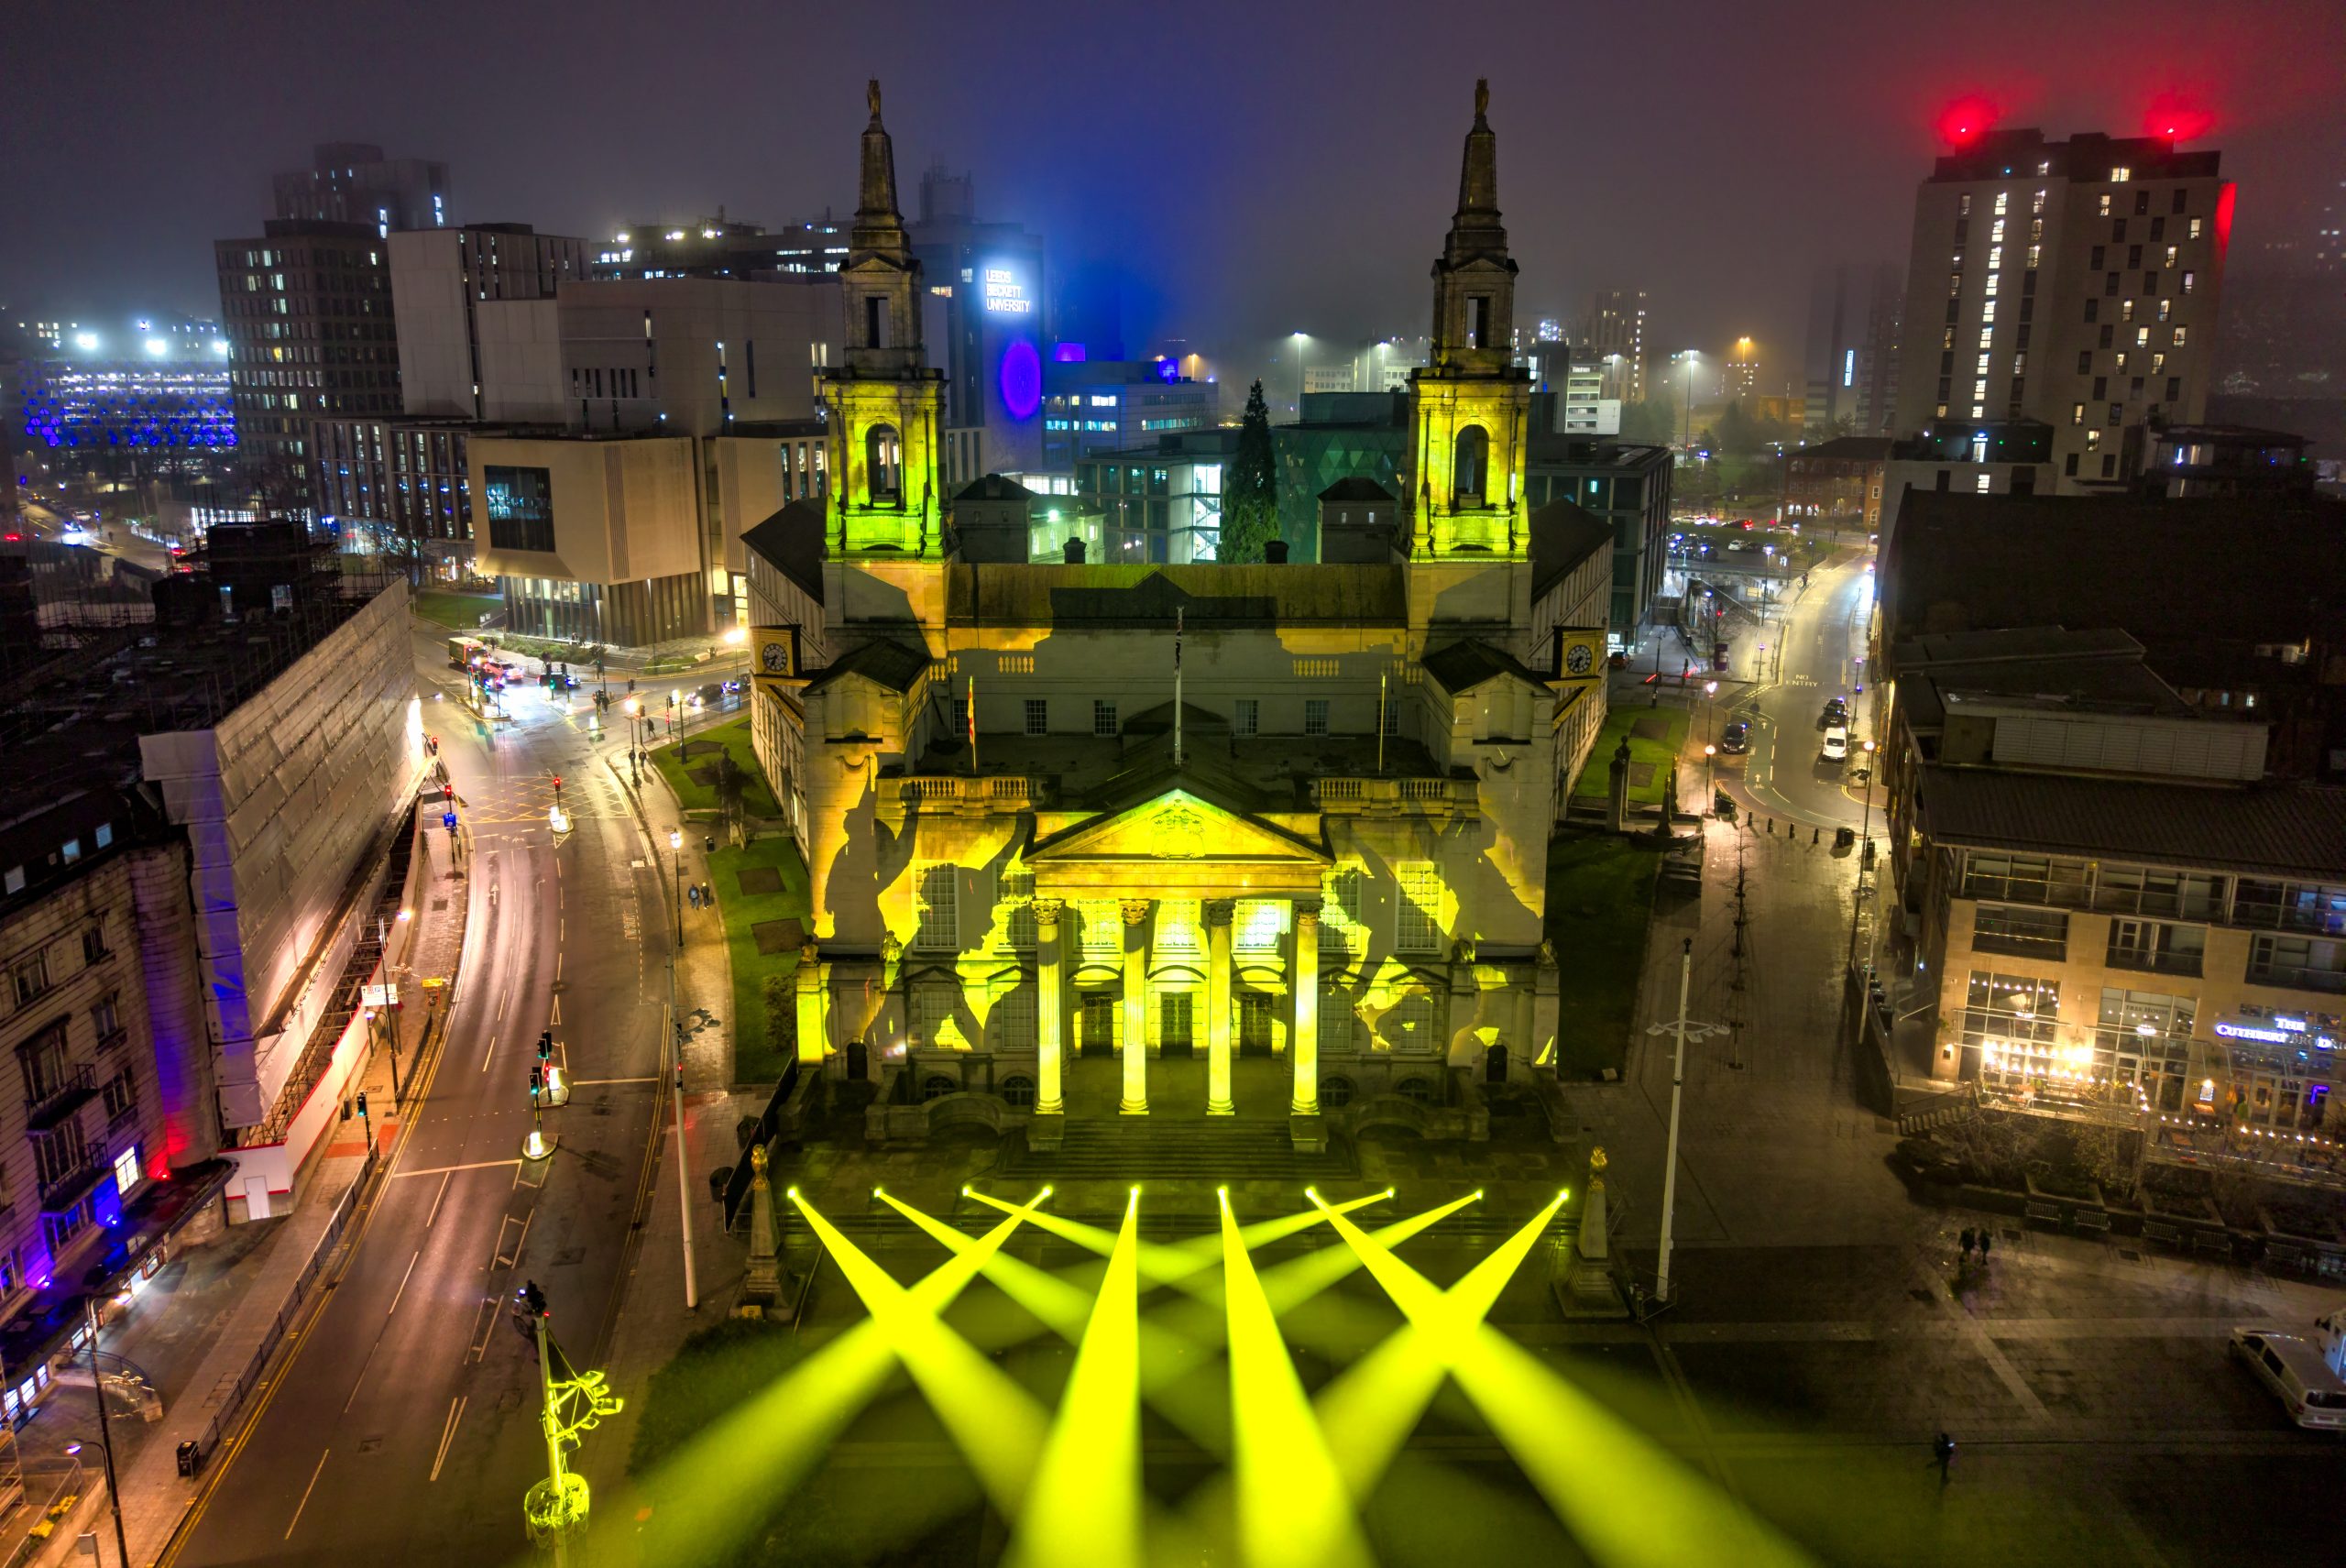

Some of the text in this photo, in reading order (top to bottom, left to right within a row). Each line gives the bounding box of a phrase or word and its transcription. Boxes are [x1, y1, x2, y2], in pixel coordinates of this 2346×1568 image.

[986, 269, 1011, 283] LEEDS
[986, 283, 1021, 298] BECKETT
[987, 298, 1030, 313] UNIVERSITY
[2275, 1016, 2306, 1032] THE
